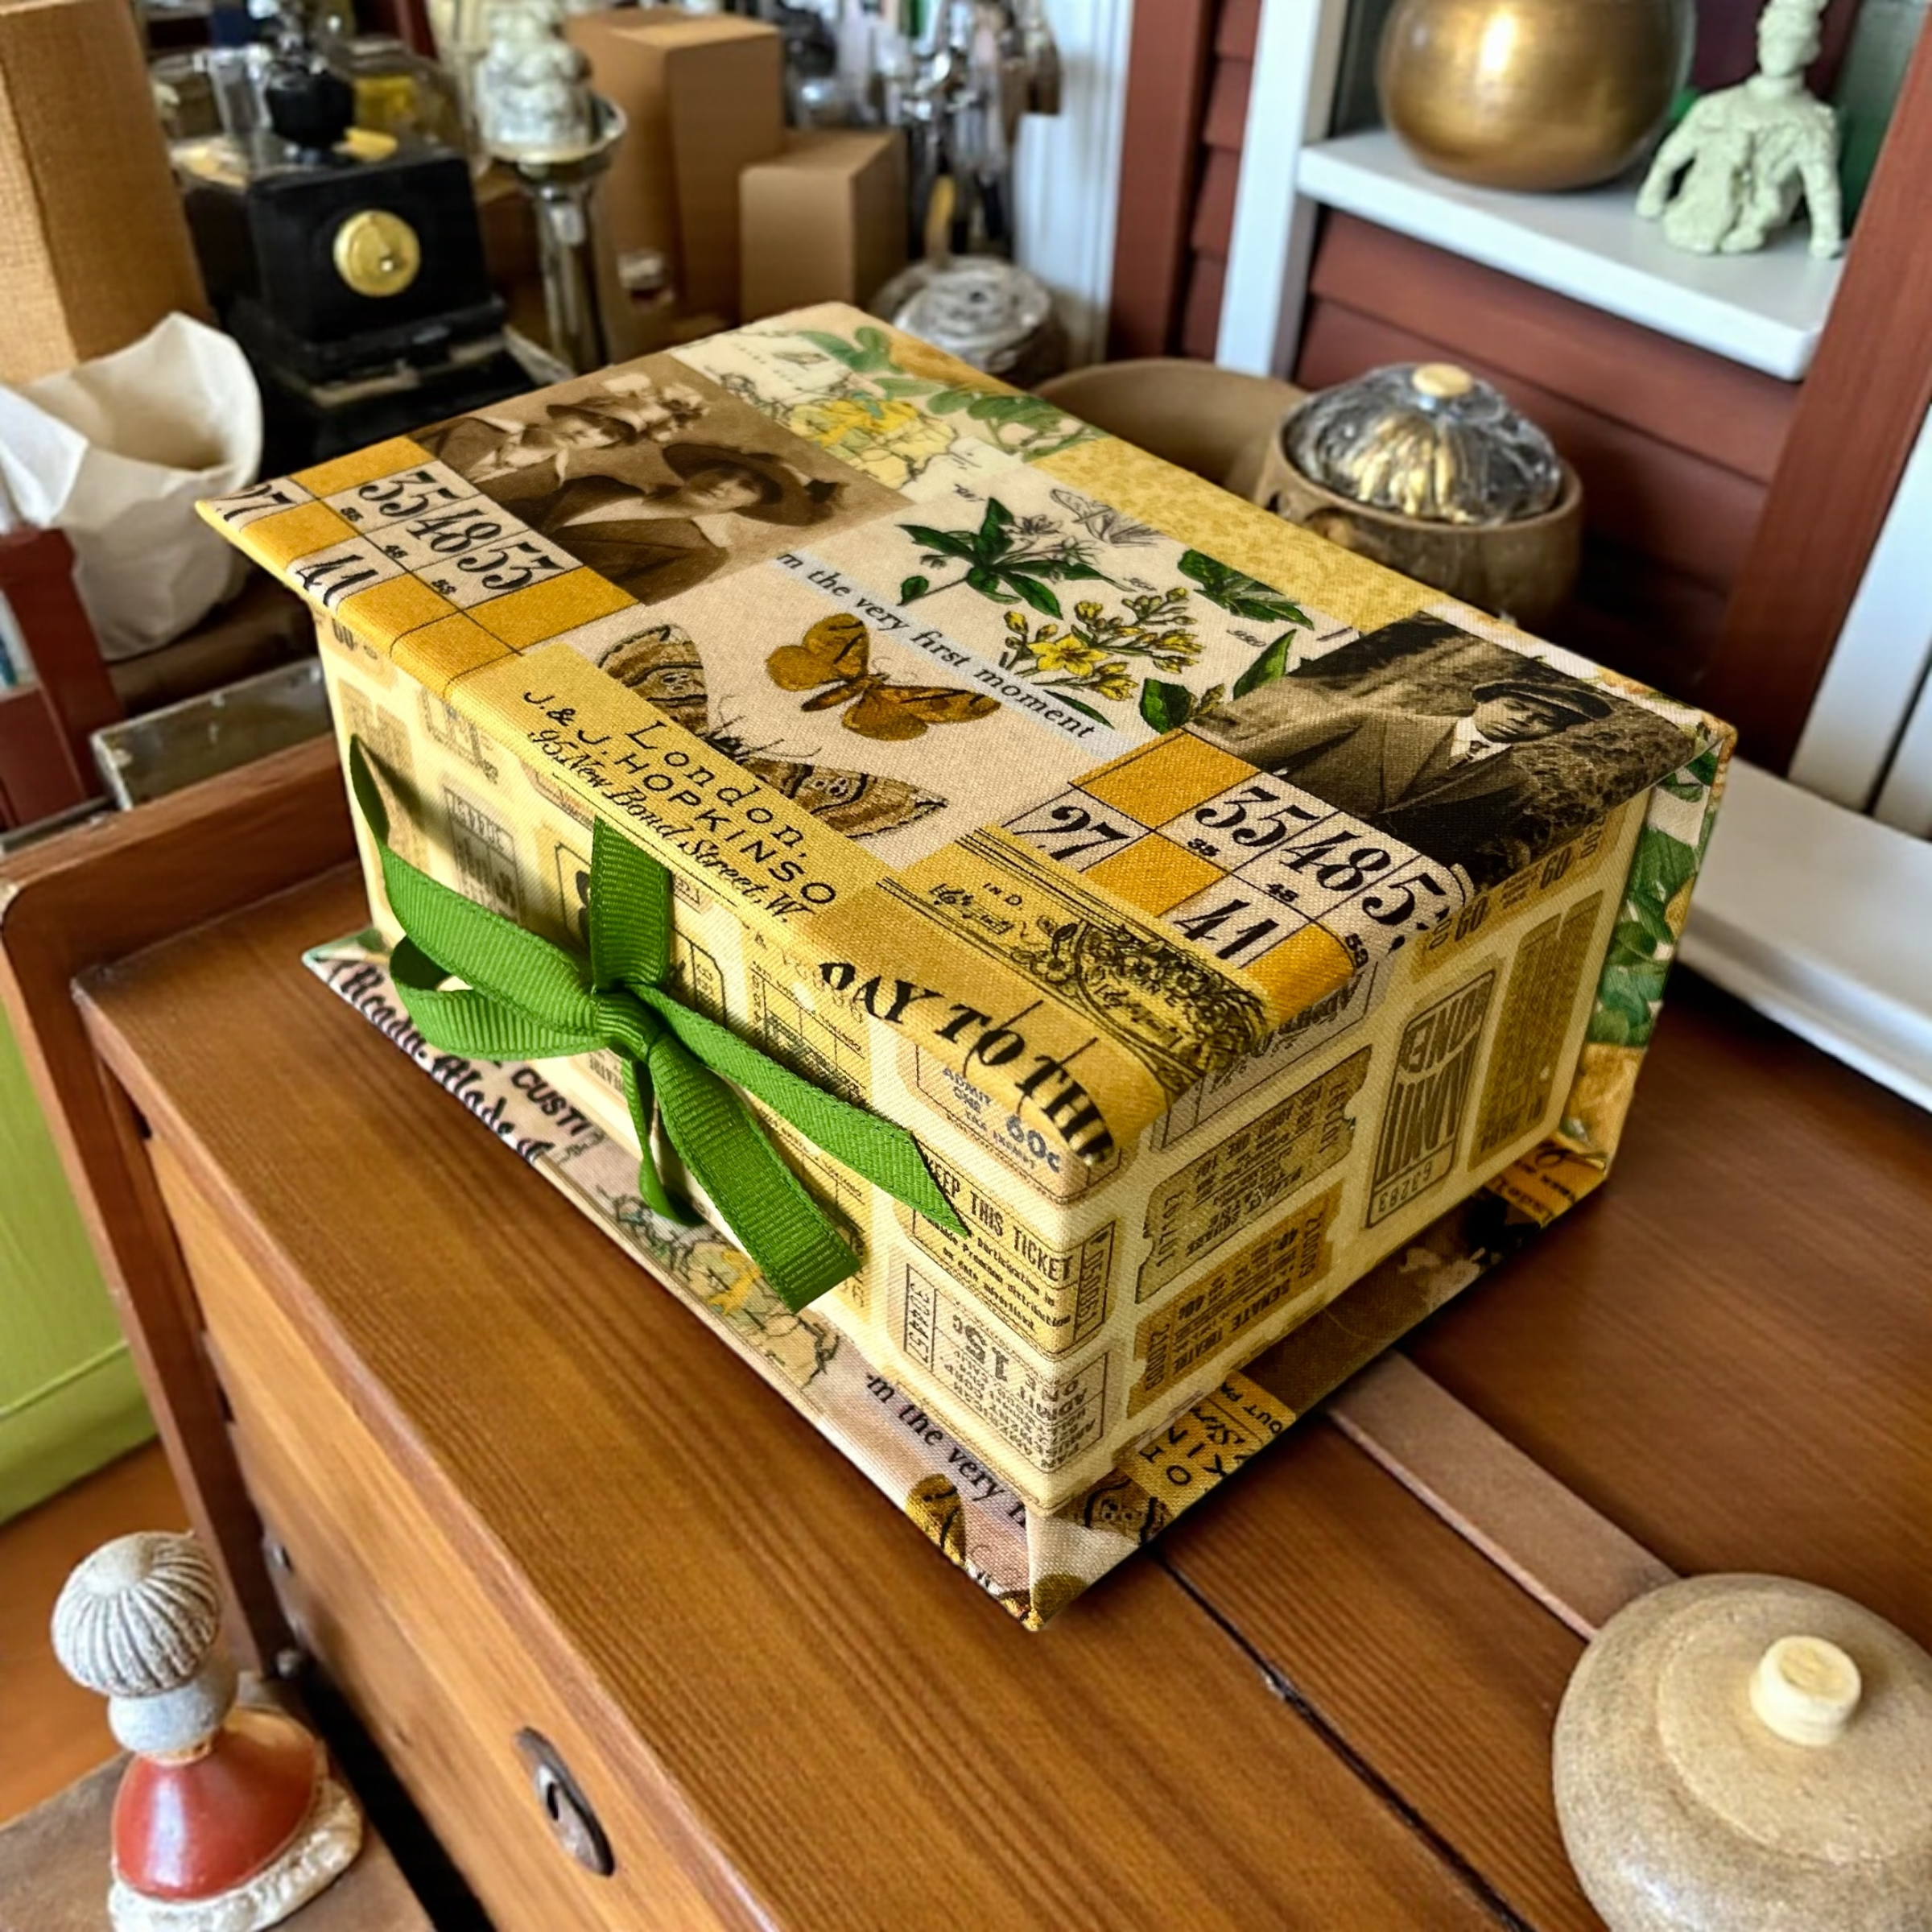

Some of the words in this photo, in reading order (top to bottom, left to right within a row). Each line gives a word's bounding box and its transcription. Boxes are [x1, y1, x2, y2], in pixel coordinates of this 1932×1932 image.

[359, 470, 463, 517] 35
[408, 508, 501, 552] 48
[297, 555, 378, 607] 41
[457, 542, 564, 590] 53
[807, 567, 850, 597] the
[855, 597, 909, 630] very
[910, 630, 971, 667] first
[973, 667, 1096, 738] moment
[604, 786, 693, 839] Bond
[1013, 807, 1131, 860] 27
[1195, 786, 1319, 846] 35
[1282, 831, 1390, 890] 48
[1173, 899, 1279, 959] 41
[969, 1191, 1004, 1237] THIS
[1013, 1224, 1074, 1283] TICKET
[899, 1404, 943, 1447] the
[948, 1447, 1005, 1502] very
